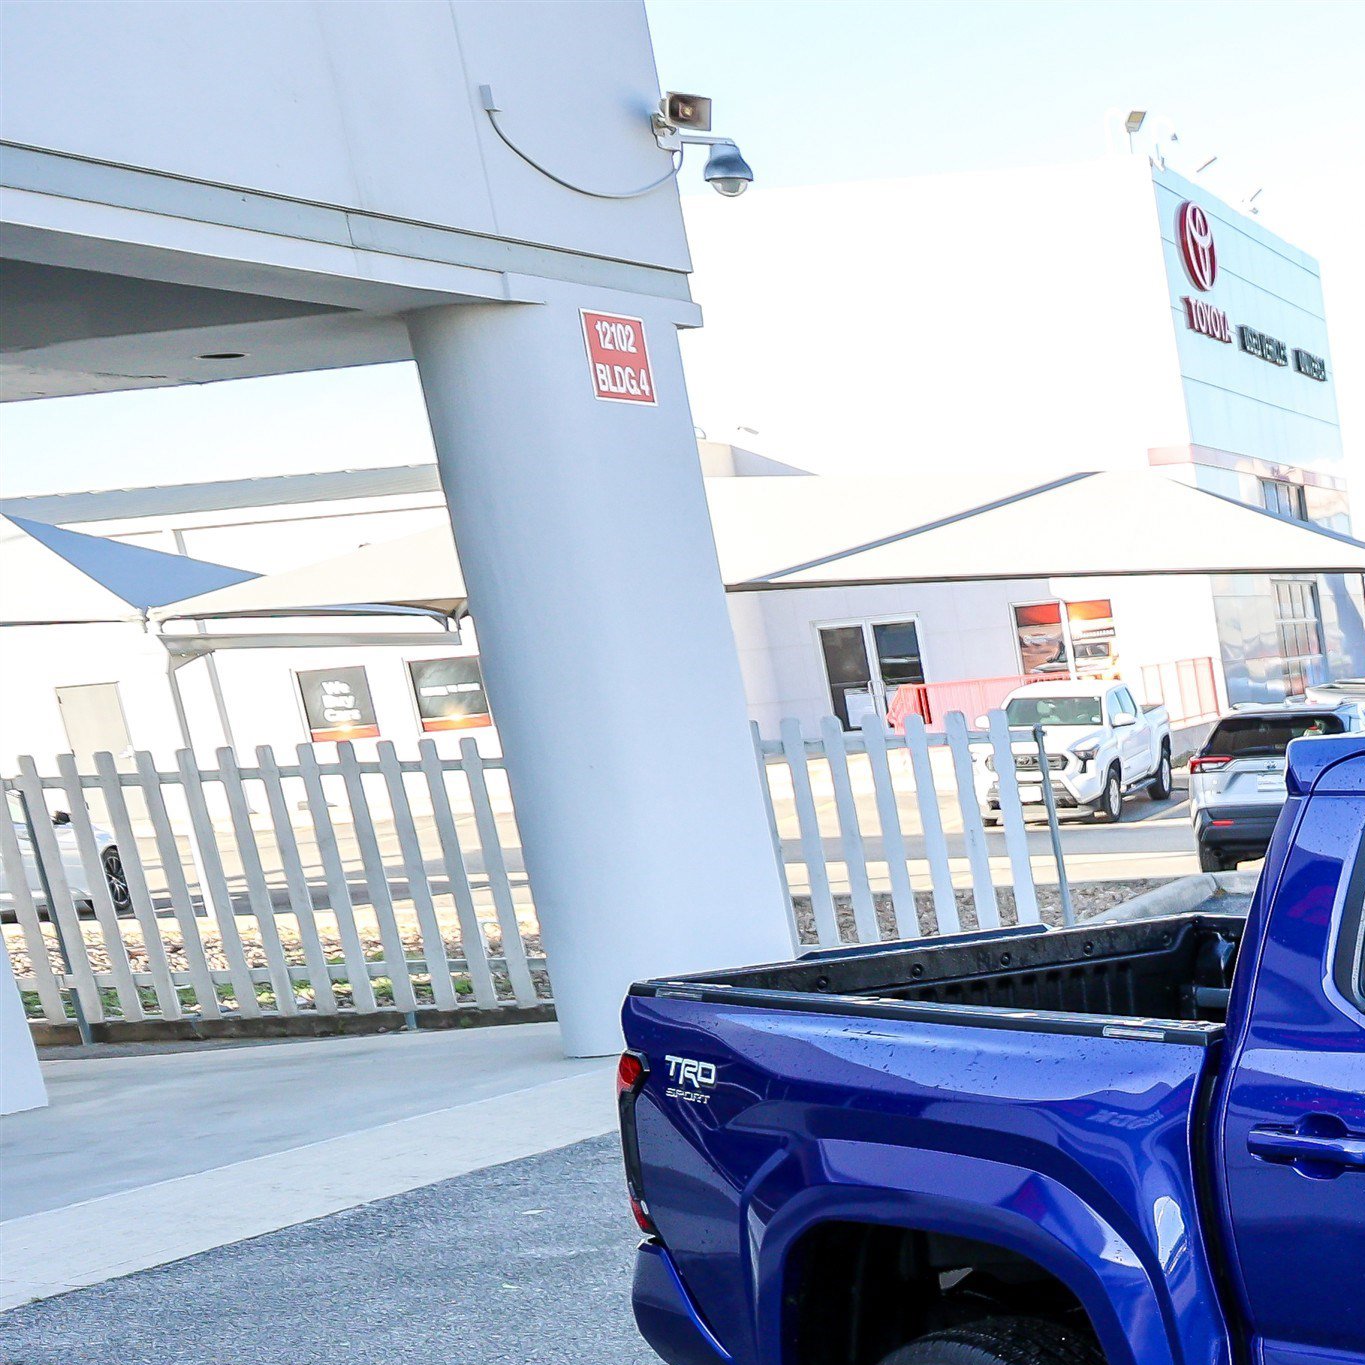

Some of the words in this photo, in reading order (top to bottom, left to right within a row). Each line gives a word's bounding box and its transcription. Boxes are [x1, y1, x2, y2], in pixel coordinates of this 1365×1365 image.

[595, 320, 638, 354] 12102
[1182, 296, 1233, 344] TOYOTA
[665, 1054, 717, 1088] TRD
[665, 1087, 711, 1104] SPORT
